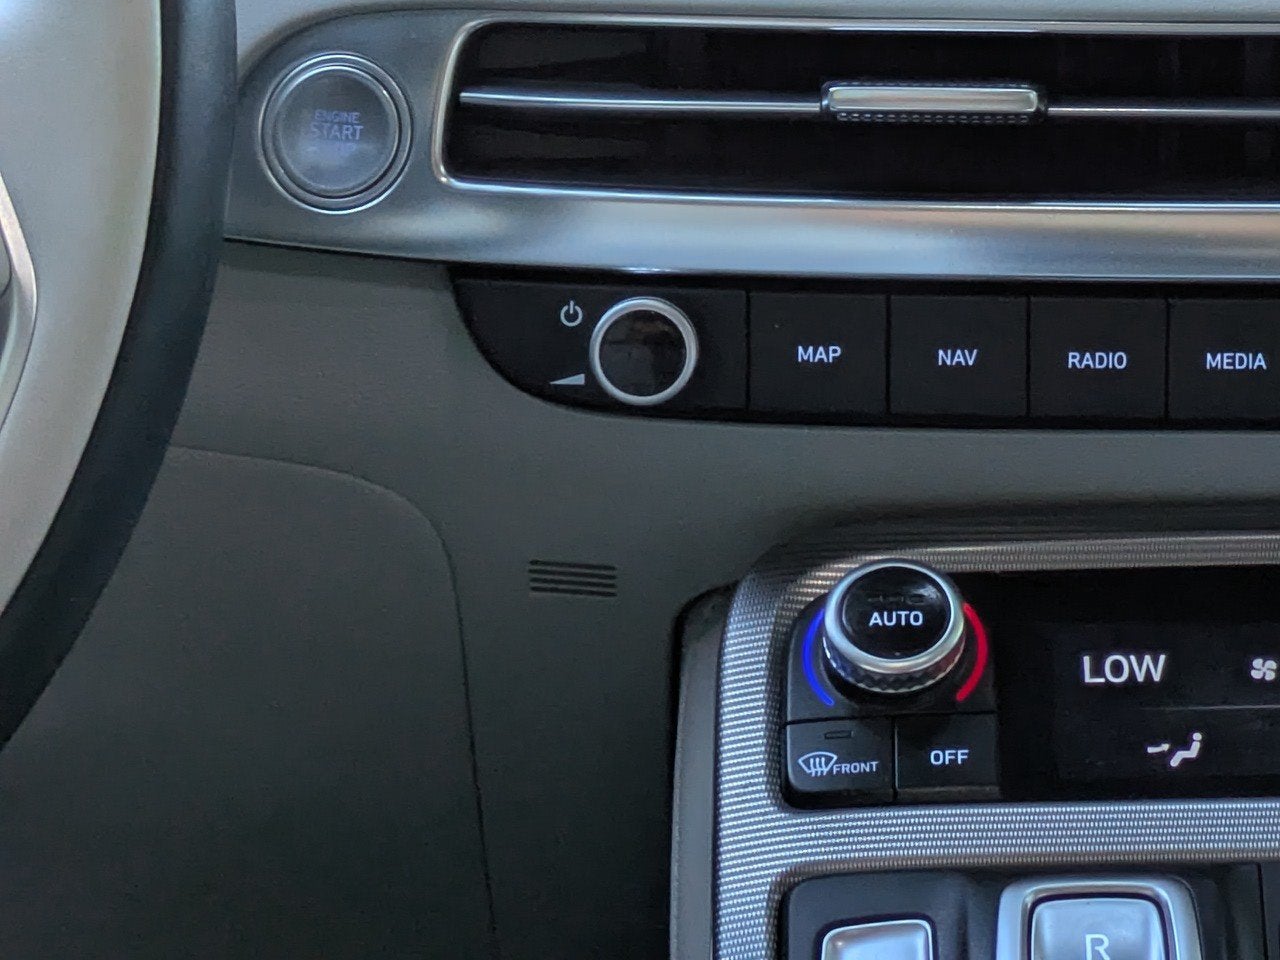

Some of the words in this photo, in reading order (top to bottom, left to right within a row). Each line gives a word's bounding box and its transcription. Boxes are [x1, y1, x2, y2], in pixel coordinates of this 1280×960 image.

[314, 109, 361, 124] ENGINE
[310, 122, 364, 140] START
[796, 345, 842, 364] MAP
[937, 349, 978, 368] NAV
[1067, 351, 1128, 370] RADIO
[1205, 352, 1268, 371] MEDIA
[868, 611, 924, 628] AUTO
[1081, 653, 1167, 685] LOW
[929, 749, 970, 766] OFF
[832, 760, 879, 776] FRONT
[1085, 933, 1111, 960] R
